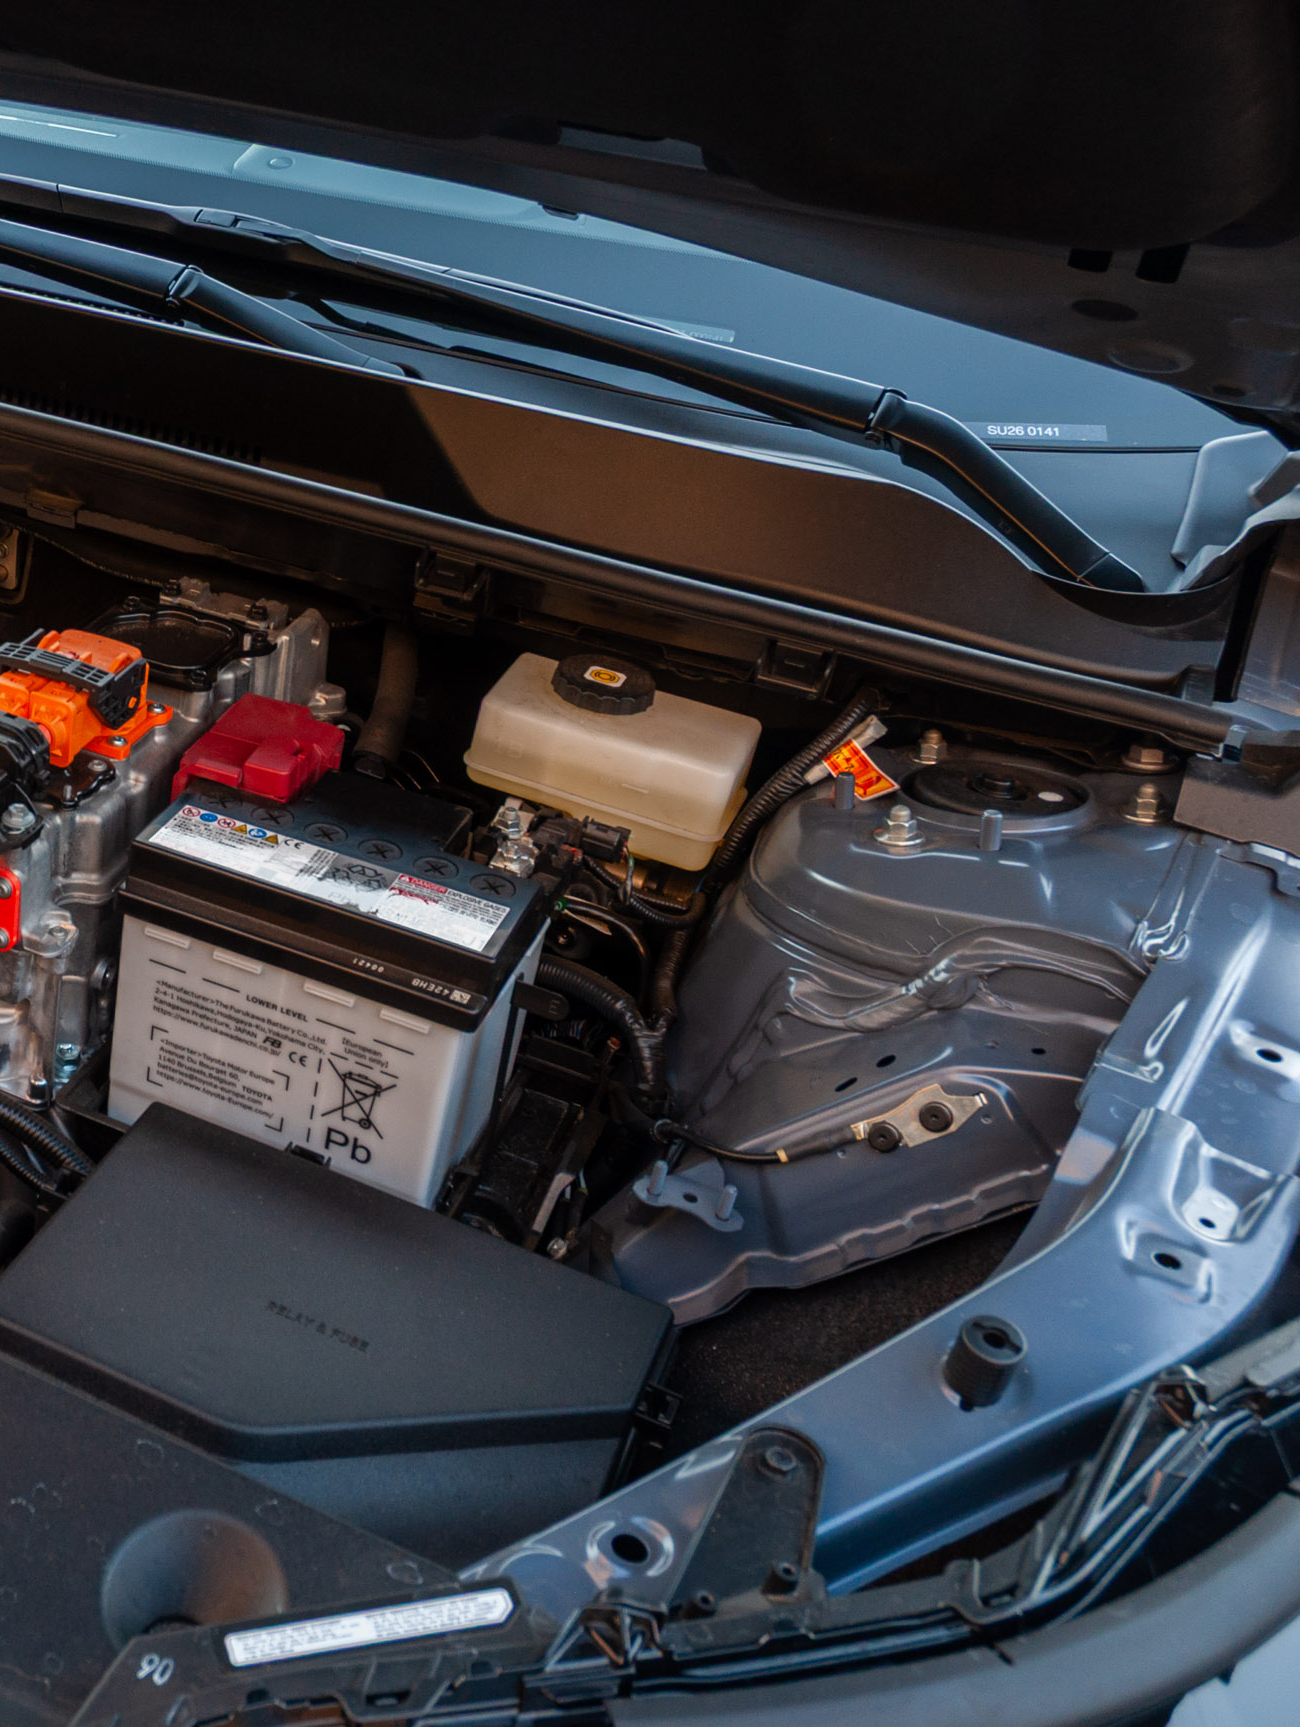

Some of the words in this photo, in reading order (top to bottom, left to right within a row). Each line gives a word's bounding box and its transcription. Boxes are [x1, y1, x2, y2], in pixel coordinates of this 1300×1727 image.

[987, 425, 1024, 436] SU26
[1027, 426, 1060, 437] 0141
[411, 877, 447, 894] DANGER
[448, 889, 483, 907] EXPLOSIVE
[483, 901, 509, 913] GASES
[154, 996, 190, 1016] Kanagawa
[191, 1008, 232, 1030] Prefecture,
[233, 1023, 258, 1039] JAPAN
[155, 987, 174, 1000] 2-4-1
[308, 1043, 326, 1056] City,
[246, 994, 278, 1011] LOWER
[280, 1006, 308, 1022] LEVEL
[267, 1015, 296, 1034] Battery
[158, 1054, 176, 1065] 1140
[159, 1046, 185, 1061] Avenue
[186, 1055, 197, 1065] Du
[198, 1060, 227, 1077] Bourget
[344, 1047, 367, 1060] Union
[227, 1062, 248, 1075] Motor
[249, 1070, 275, 1085] Europe
[241, 1085, 273, 1102] TOYOTA
[324, 1126, 372, 1164] Pb
[266, 1301, 316, 1327] RELAY
[316, 1321, 327, 1335] &
[330, 1327, 370, 1352] FUSE
[136, 1652, 175, 1686] 90
